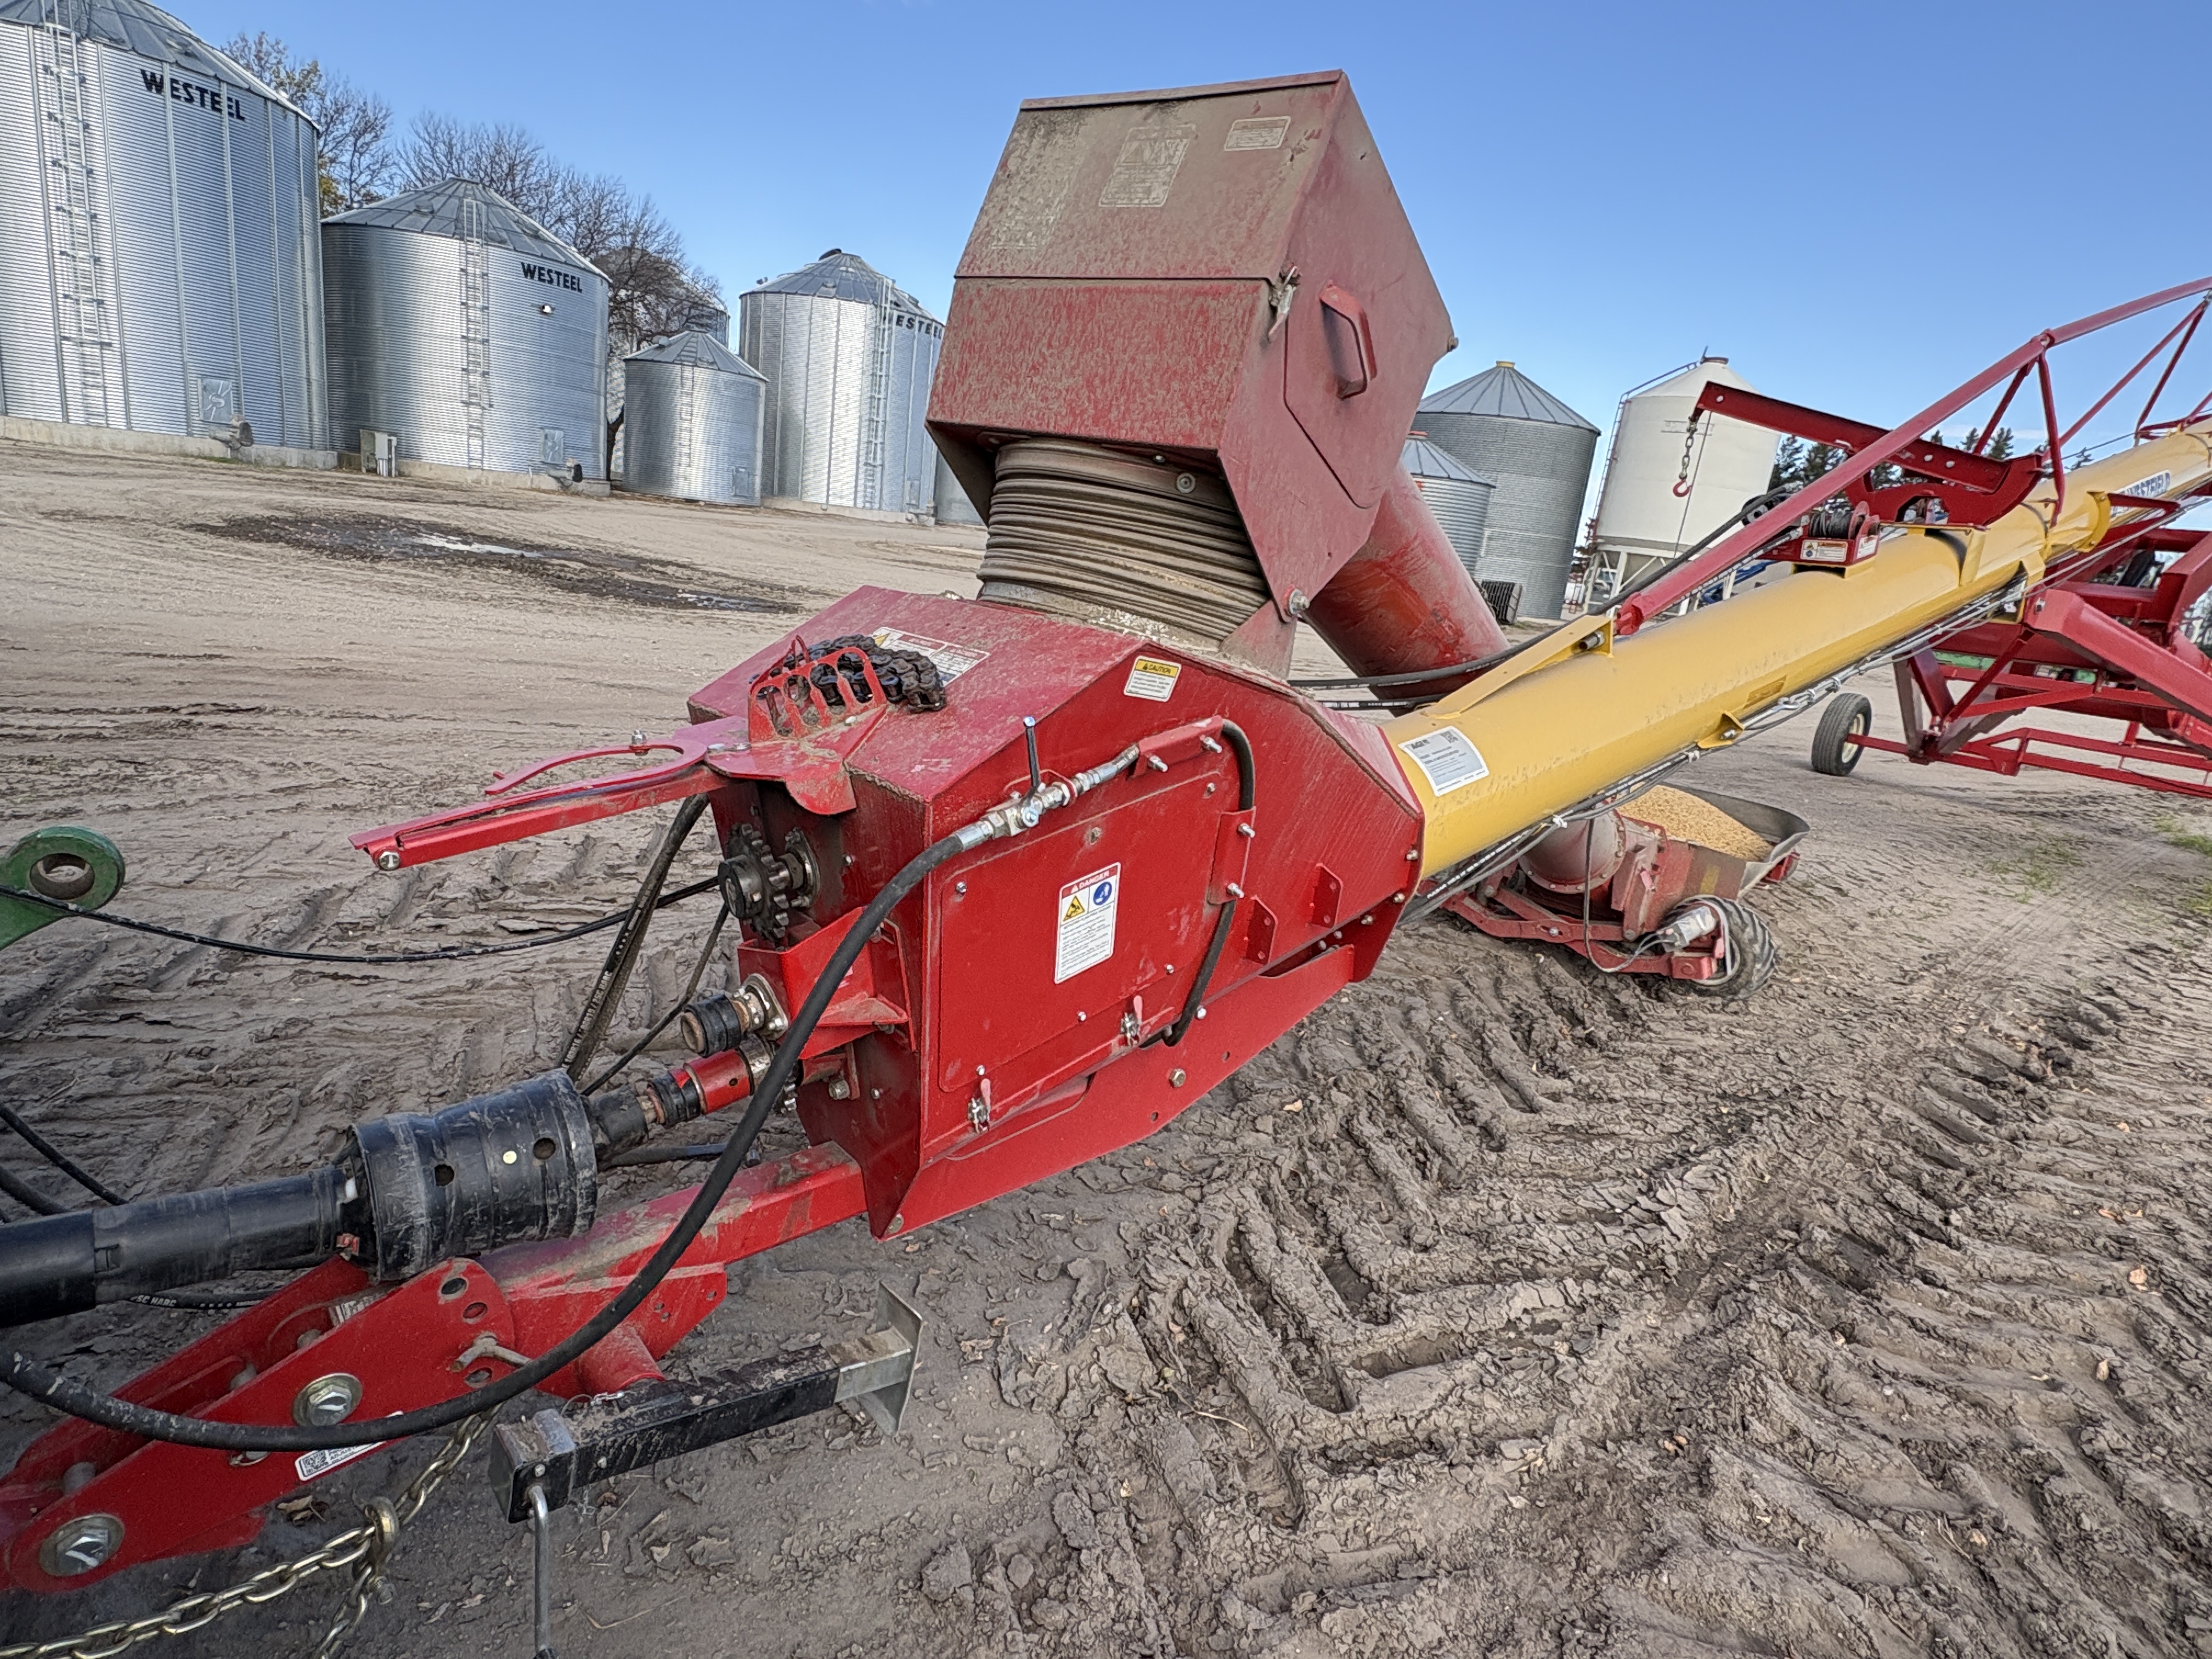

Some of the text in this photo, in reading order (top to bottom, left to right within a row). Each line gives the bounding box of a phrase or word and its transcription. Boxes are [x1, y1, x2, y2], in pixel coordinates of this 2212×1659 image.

[140, 69, 245, 121] WESTEEL
[521, 262, 582, 293] WESTEEL
[883, 314, 942, 340] ESTEEL
[1149, 664, 1171, 674] CAUTION
[1079, 870, 1109, 889] DANGER
